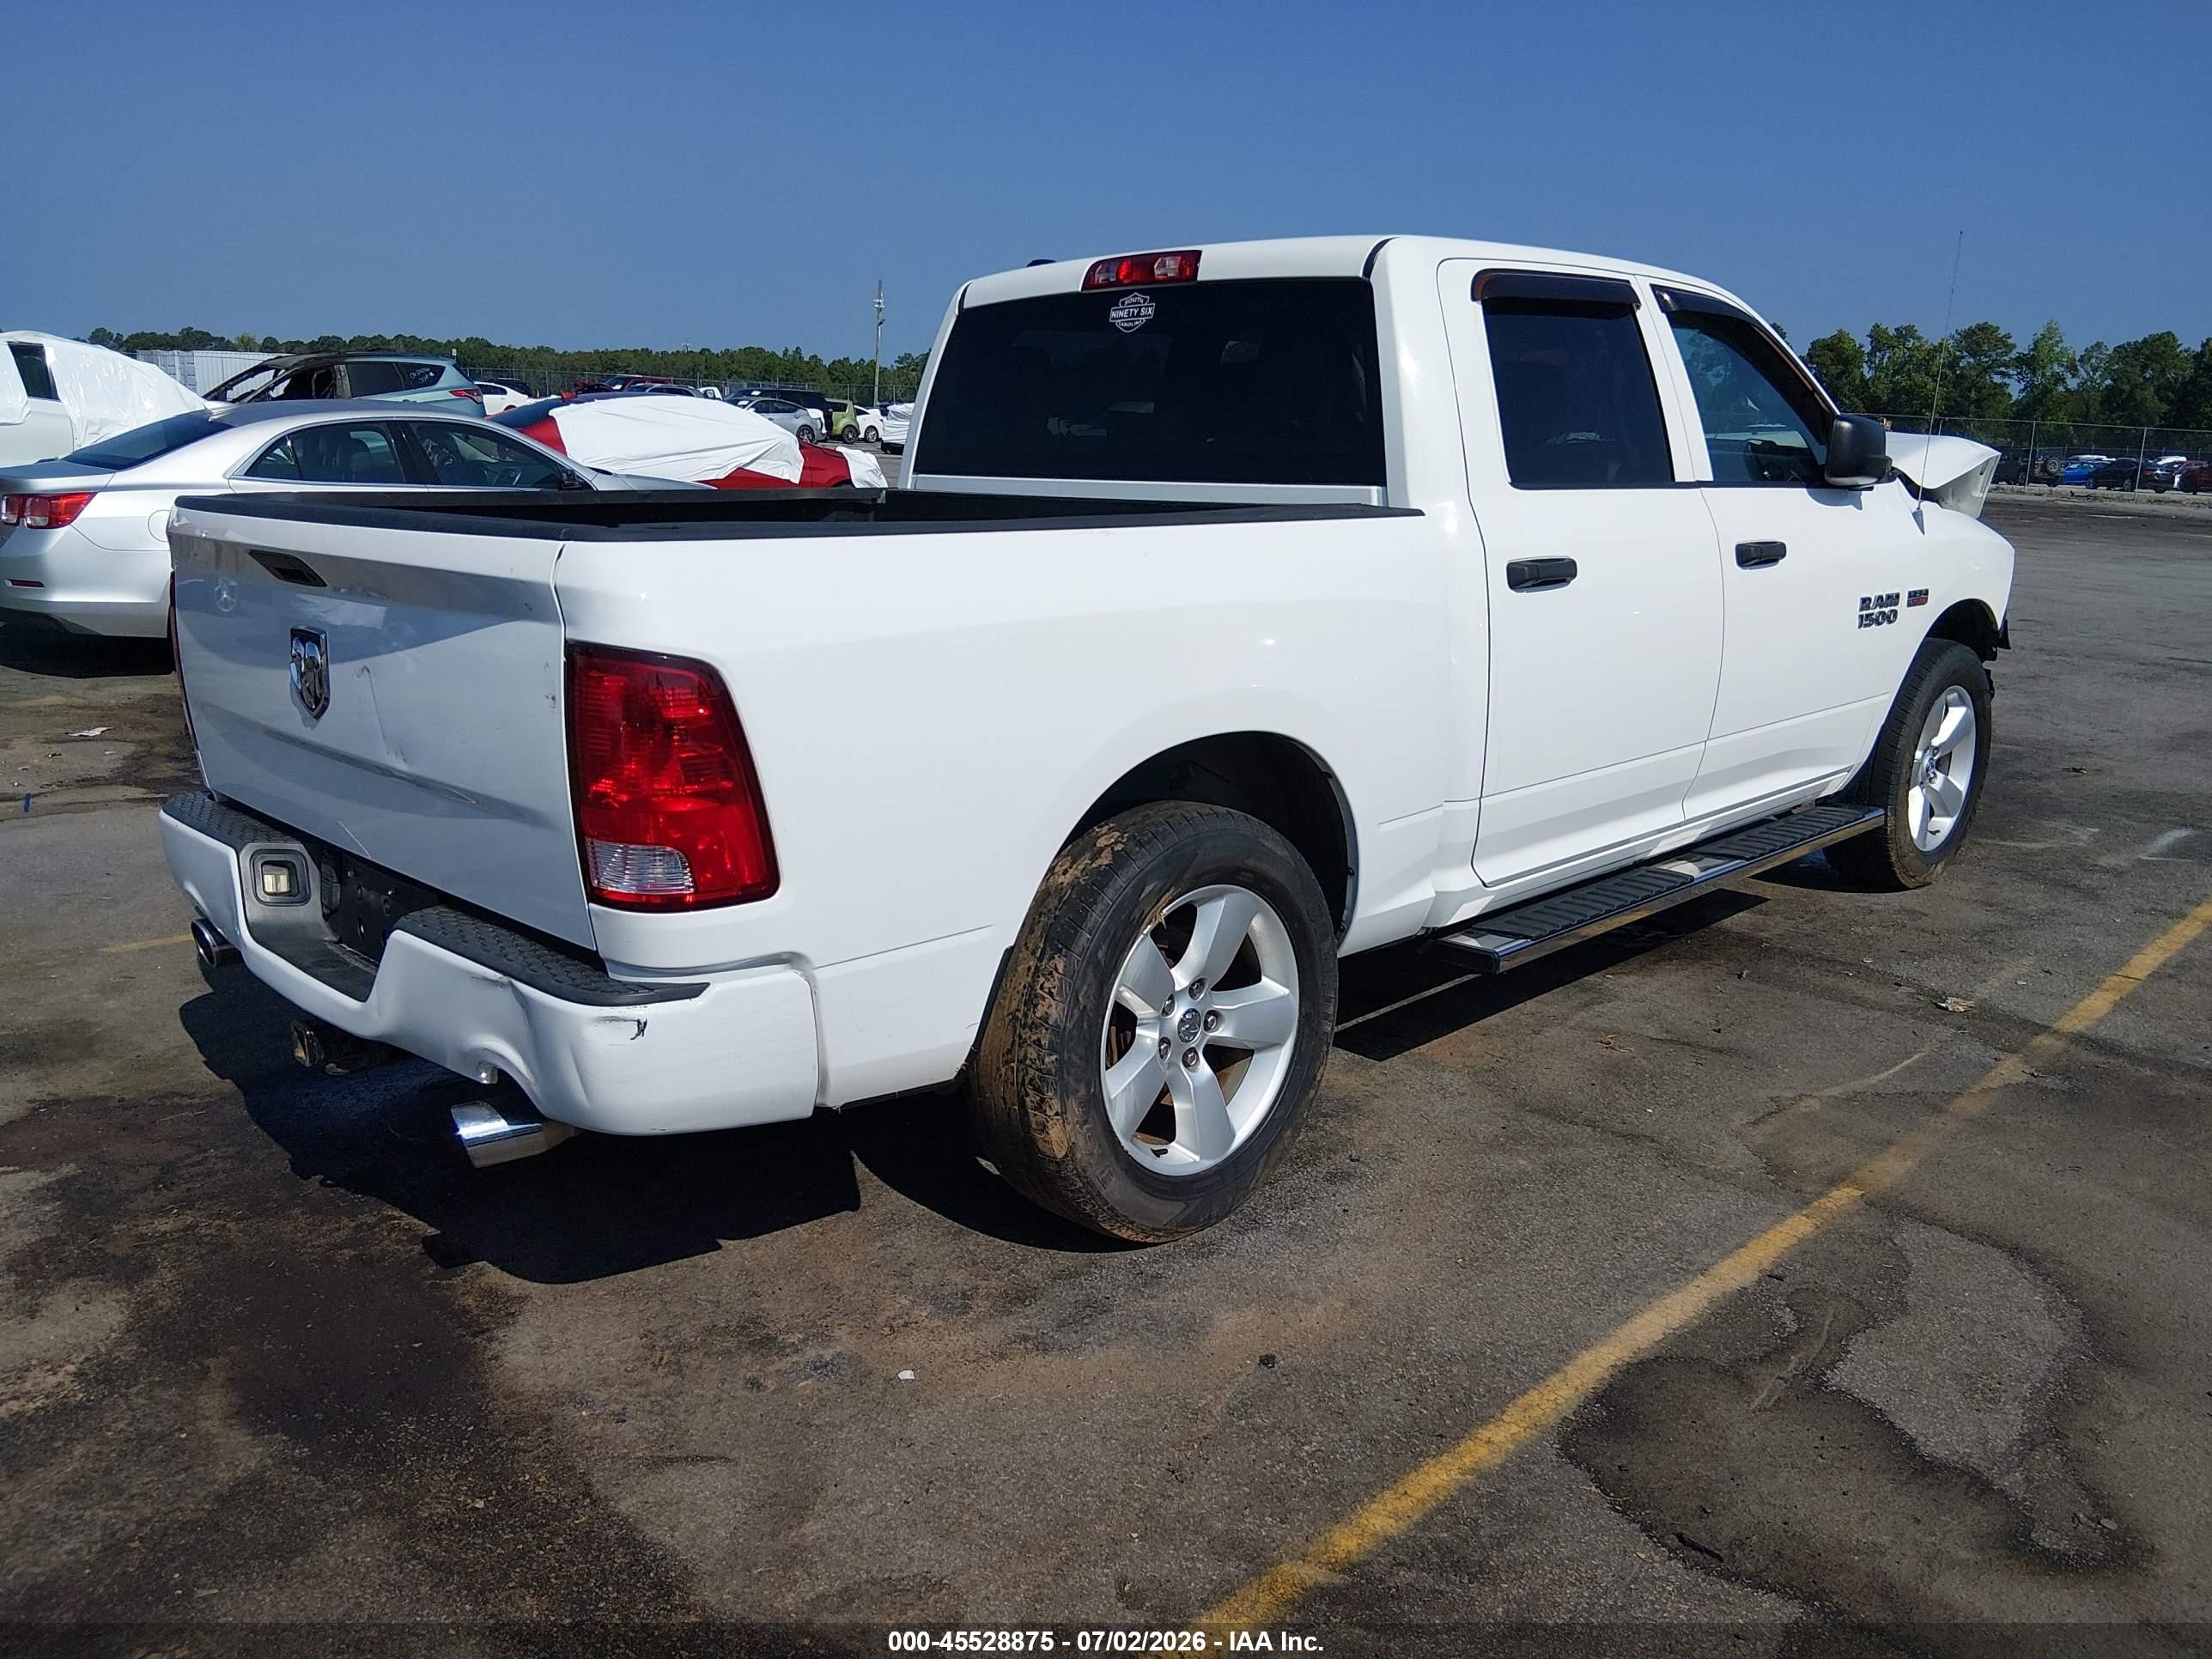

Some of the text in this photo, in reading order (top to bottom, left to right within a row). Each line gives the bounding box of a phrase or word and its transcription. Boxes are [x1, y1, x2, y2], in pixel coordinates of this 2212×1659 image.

[1124, 296, 1144, 306] SOUTH
[1111, 307, 1153, 319] NINETY SIX
[1858, 592, 1900, 612] RAM
[1857, 609, 1899, 629] 1500
